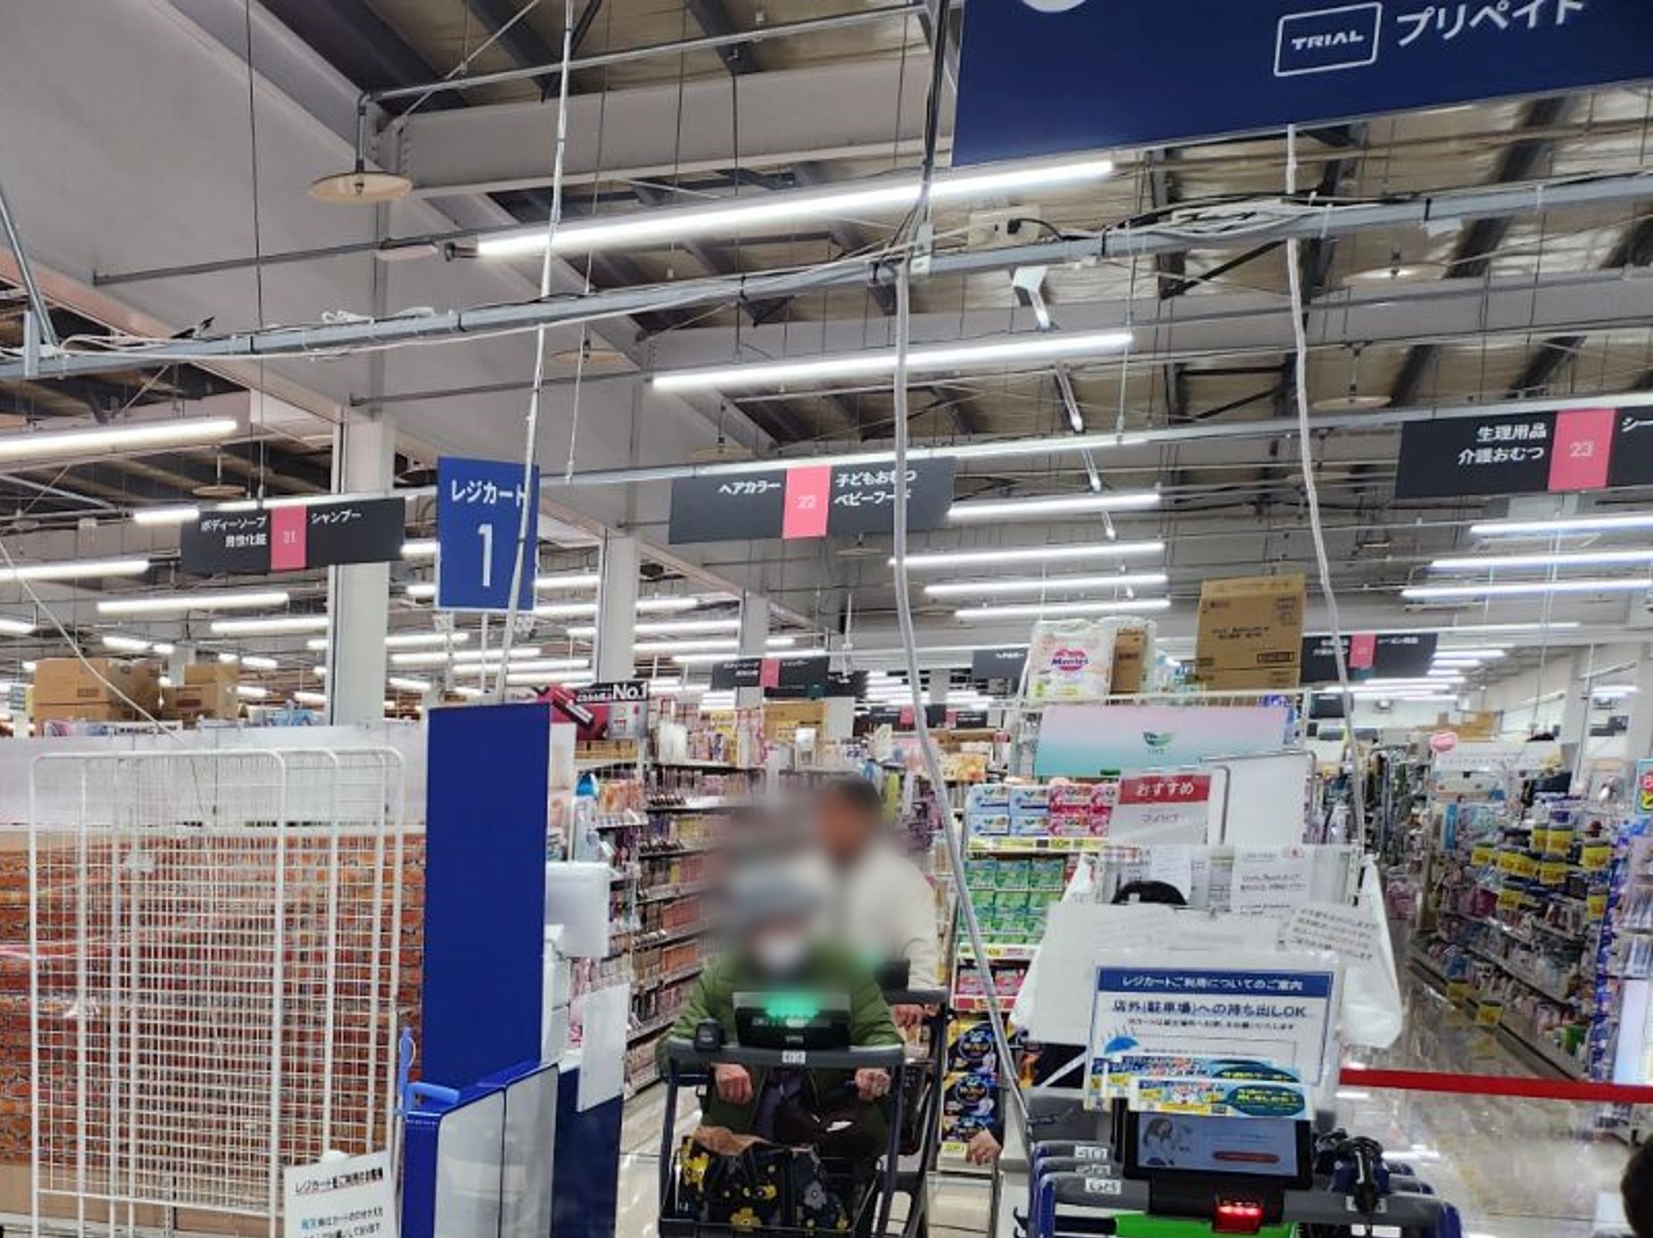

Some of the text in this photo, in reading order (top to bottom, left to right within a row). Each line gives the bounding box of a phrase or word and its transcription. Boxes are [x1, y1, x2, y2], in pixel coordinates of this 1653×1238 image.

[1292, 29, 1364, 50] TRIAL
[1477, 422, 1547, 443] 生理用品
[1458, 447, 1545, 466] 介護おむつ
[1570, 441, 1594, 457] 23
[835, 469, 917, 487] 子どもおむつ
[452, 480, 527, 508] レジカート
[719, 481, 781, 494] ヘアカラー
[798, 495, 817, 507] 22
[200, 515, 268, 532] ボディーソープ
[311, 509, 362, 525] シャンプー
[478, 524, 492, 587] 1
[1135, 782, 1194, 797] おすすめ
[1122, 976, 1303, 991] レジカートご利用についてのご案内
